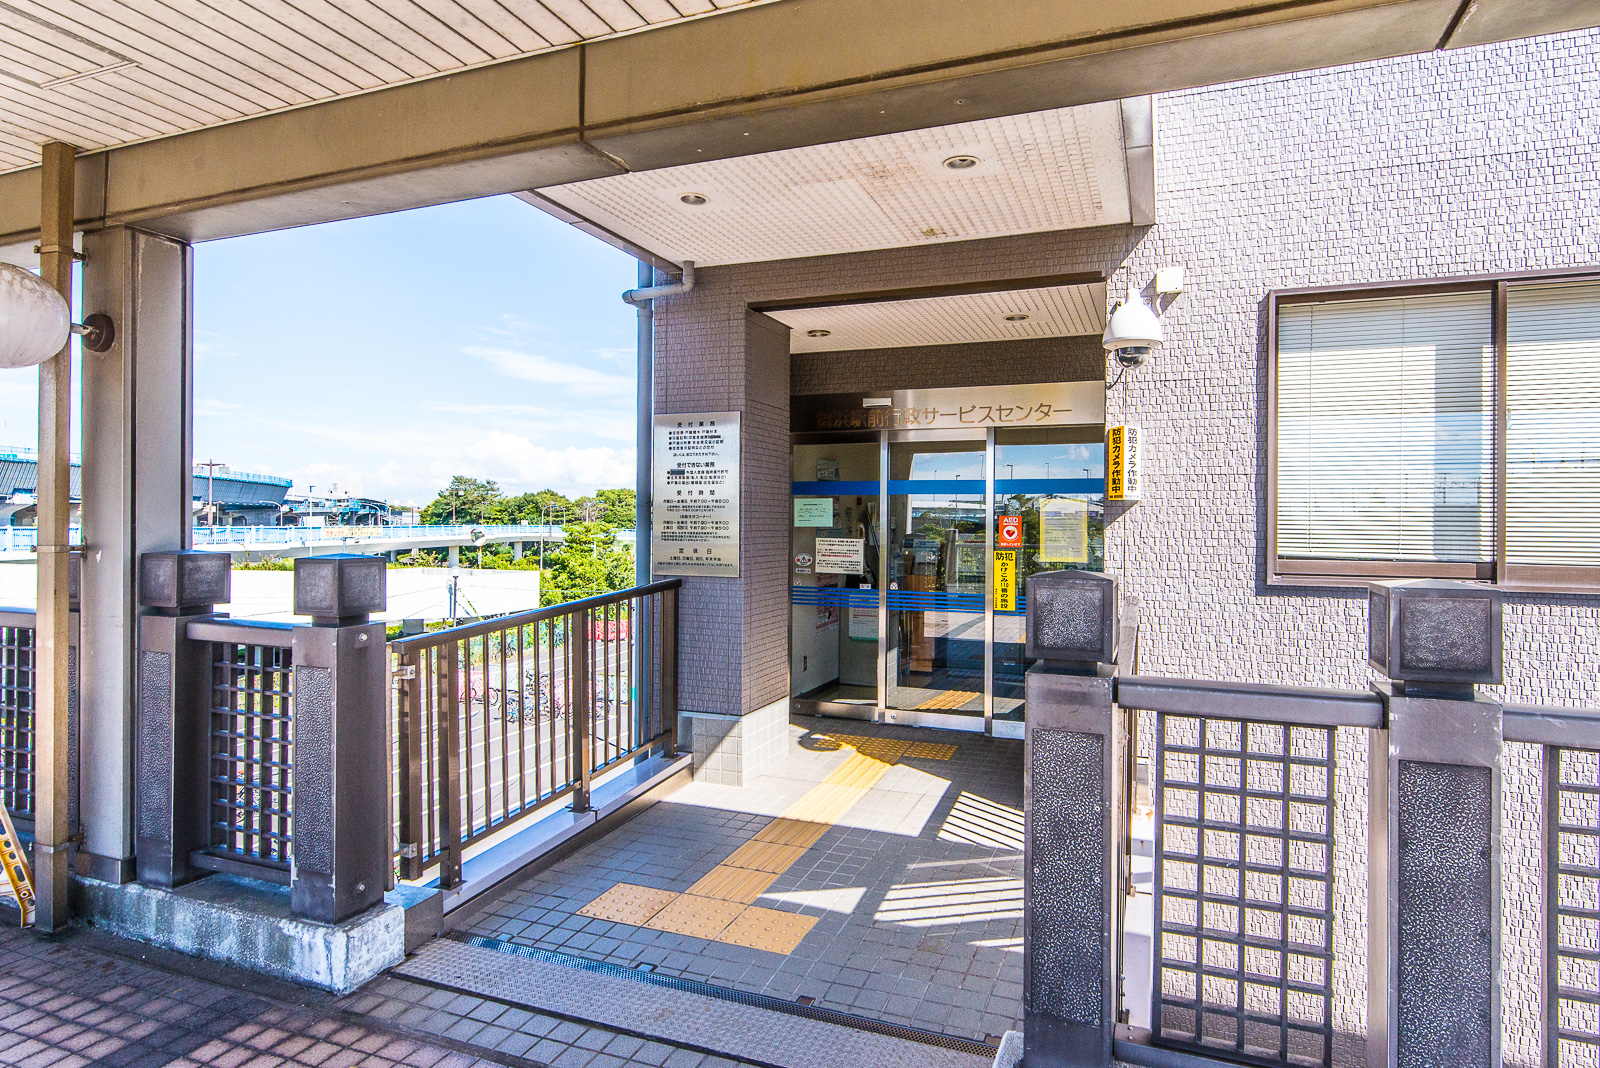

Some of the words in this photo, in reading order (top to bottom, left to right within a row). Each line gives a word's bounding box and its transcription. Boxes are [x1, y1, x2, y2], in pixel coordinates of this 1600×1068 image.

[1112, 428, 1121, 493] 防犯カメラ作動中
[1128, 428, 1137, 493] 防犯カメラ作動中
[995, 552, 1014, 561] 防犯
